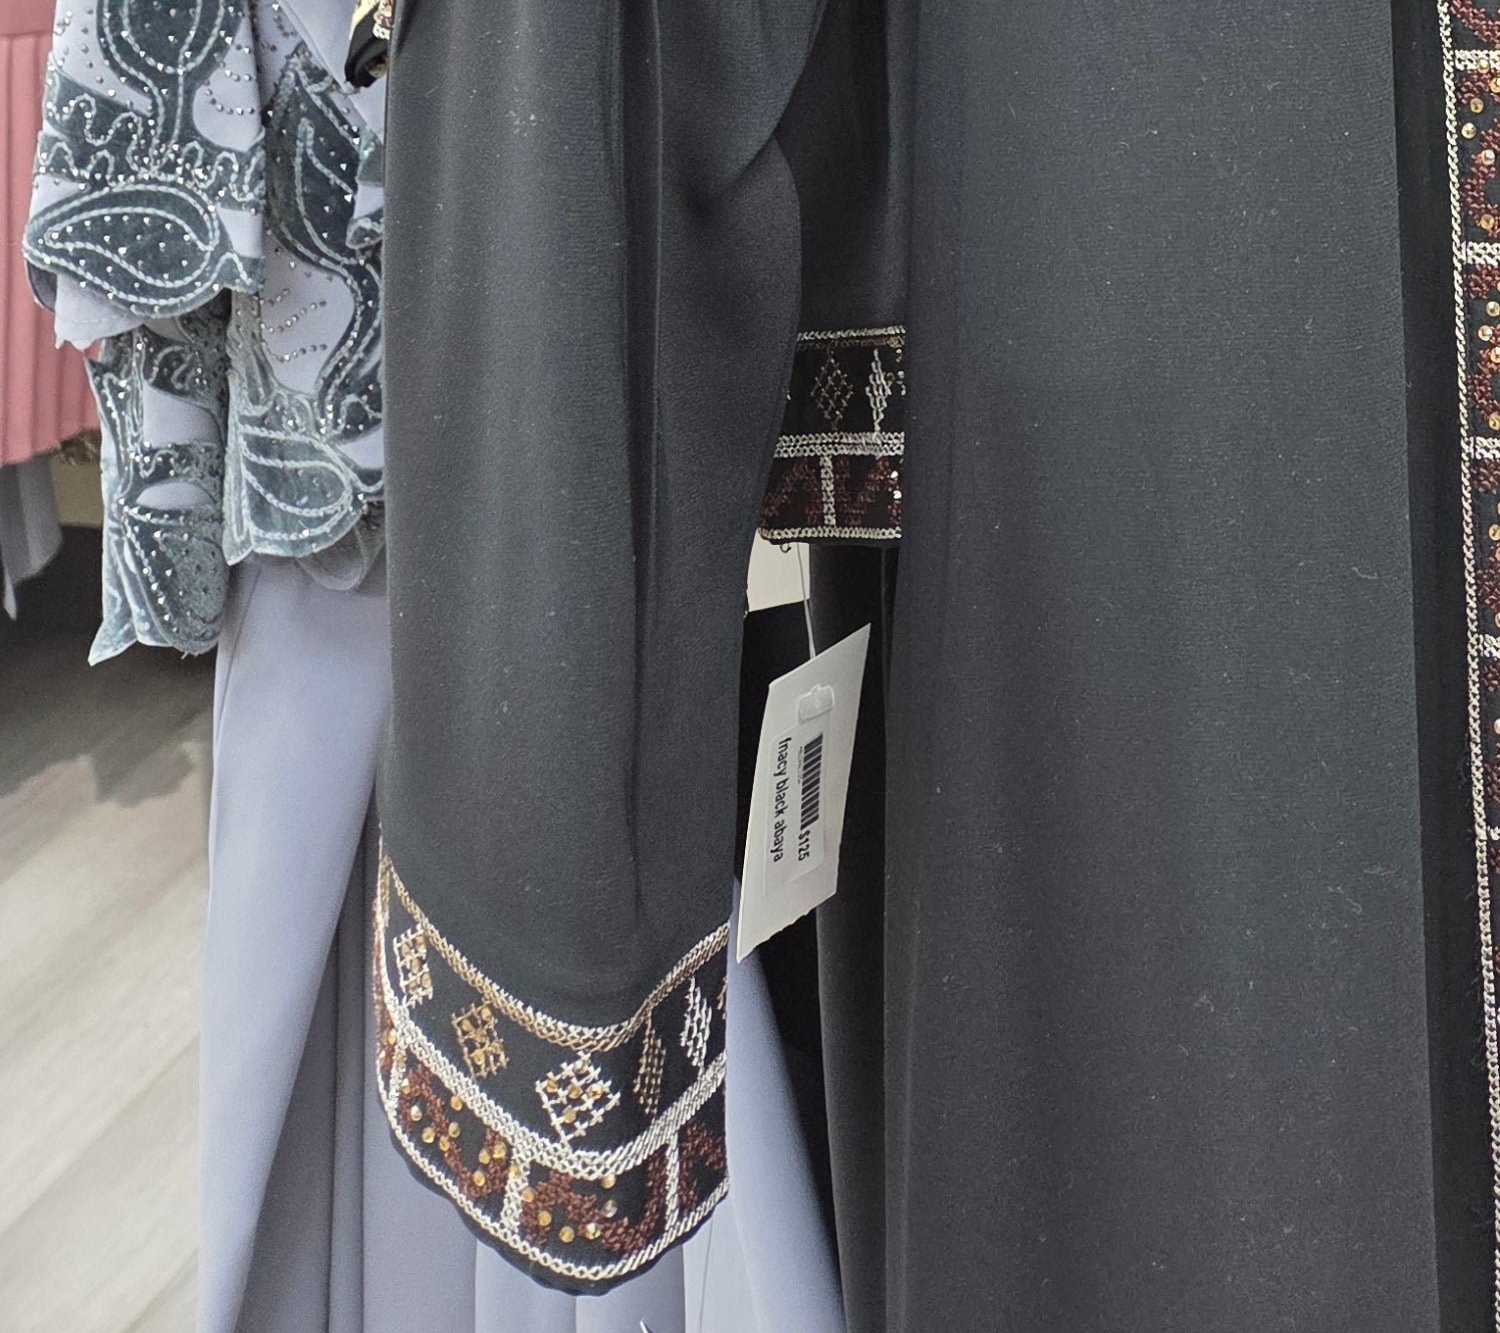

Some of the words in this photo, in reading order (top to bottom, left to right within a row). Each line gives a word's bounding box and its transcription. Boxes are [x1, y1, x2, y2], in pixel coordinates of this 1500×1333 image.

[773, 737, 792, 777] fnacy
[775, 778, 789, 818] black
[770, 820, 787, 862] abaya
[798, 829, 811, 861] $125
